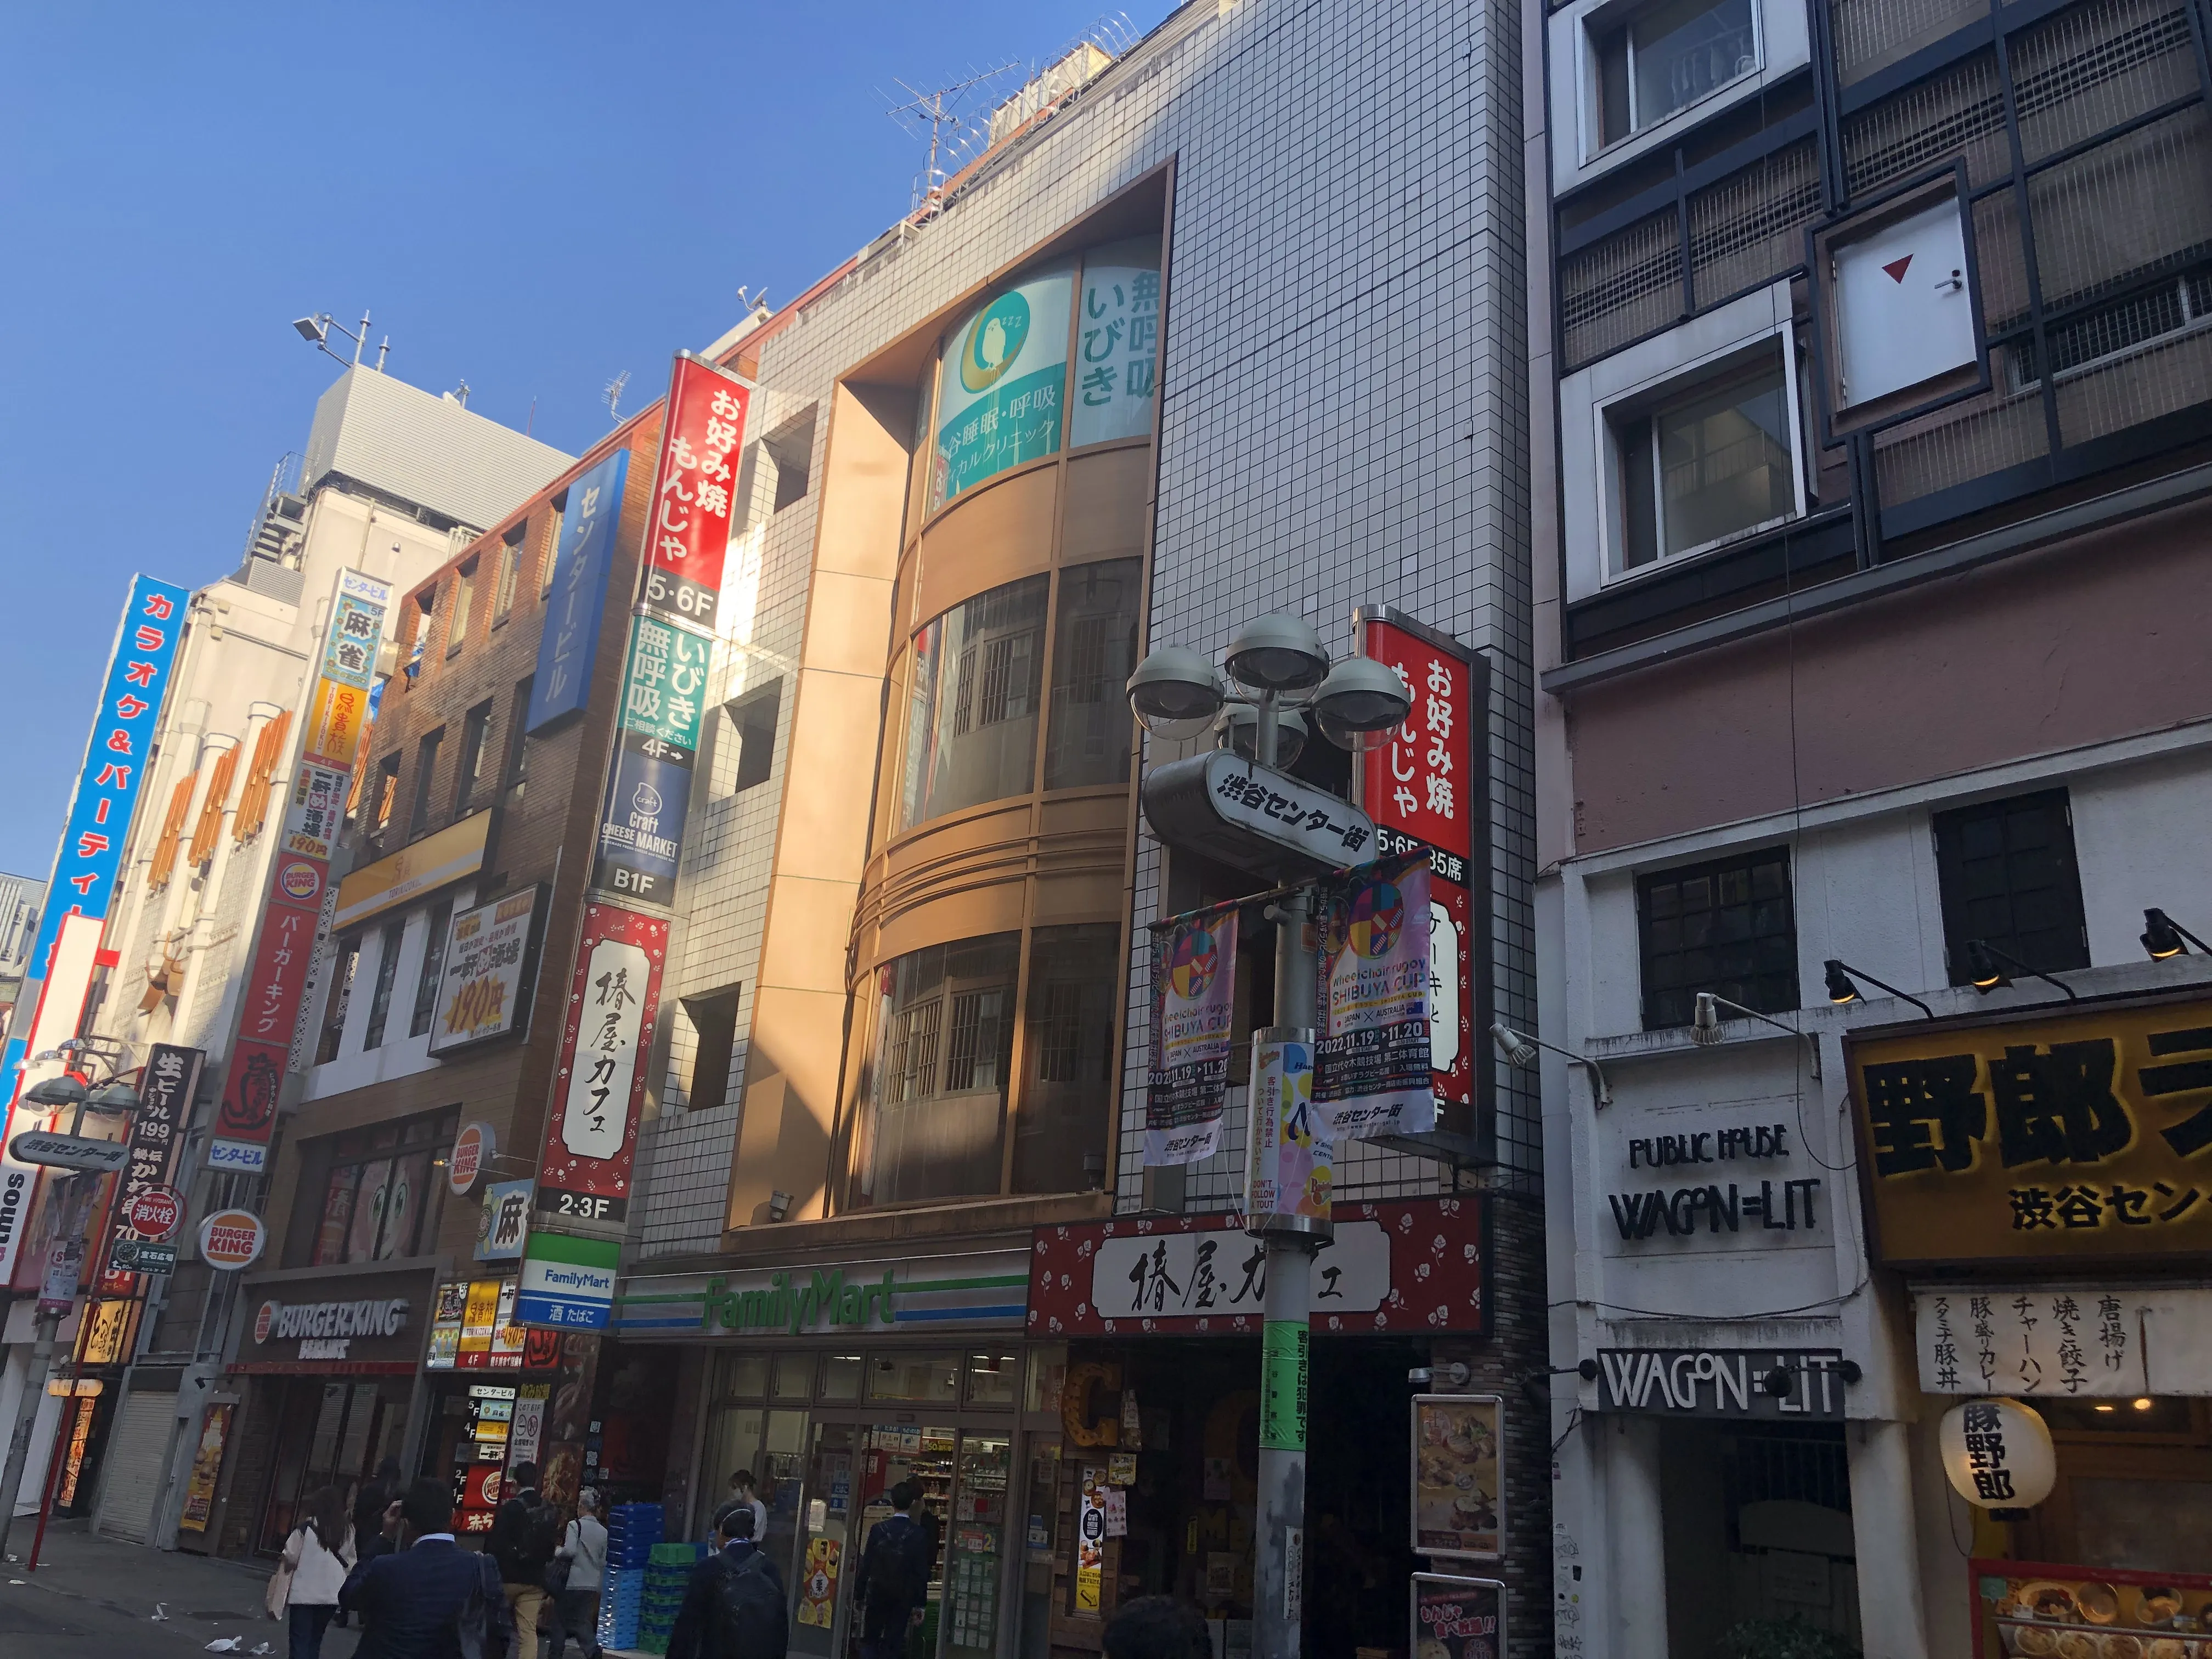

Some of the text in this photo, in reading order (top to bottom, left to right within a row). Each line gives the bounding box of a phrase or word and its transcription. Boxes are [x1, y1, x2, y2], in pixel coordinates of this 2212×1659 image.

[1082, 284, 1125, 407] いびき
[696, 389, 741, 518] お好み焼
[659, 436, 697, 561] もんじゃ
[344, 577, 387, 600] センタービル
[545, 486, 600, 702] センタービル
[370, 607, 384, 618] 5F
[338, 611, 372, 670] 麻雀
[629, 620, 671, 721] 無呼吸
[668, 633, 705, 730] いびき
[327, 692, 354, 755] 鳥貴族
[624, 716, 692, 746] ご相談ください
[642, 738, 669, 758] 4F
[1426, 659, 1454, 820] お好み焼
[629, 811, 659, 834] Craft
[1217, 772, 1370, 853] 渋谷センター街
[602, 823, 678, 859] CHEESE MARKET
[284, 877, 315, 888] KING
[285, 871, 315, 880] BURGER
[613, 868, 654, 894] B1F
[258, 915, 300, 1033] バーガーキング
[1333, 966, 1390, 988] wheelchair
[1332, 972, 1426, 1006] SHIBUYA CUP
[1344, 1012, 1361, 1024] JAPAN
[1376, 1004, 1405, 1018] AUSTRALIA
[1388, 1021, 1423, 1041] 11.20
[583, 967, 637, 1133] 椿屋カフェ
[1193, 1042, 1220, 1053] AUSTRALIA
[1324, 1047, 1430, 1074] 国立代々木競技場 第二体育館
[149, 1052, 184, 1120] 生ビール
[1264, 1076, 1276, 1148] 客引き行為禁止
[1333, 1103, 1403, 1125] 渋谷センター街
[139, 1120, 170, 1138] 199
[24, 1138, 125, 1163] 渋谷センター街
[132, 1147, 163, 1163] 秘伝
[211, 1144, 263, 1165] センタービル
[456, 1144, 479, 1159] BURGER
[1629, 1124, 1790, 1169] PUBLIC HOUSE
[453, 1156, 478, 1175] KING
[1251, 1189, 1276, 1199] FOLLOW
[1252, 1179, 1273, 1189] DON'T
[134, 1203, 174, 1224] 消火栓
[1256, 1200, 1274, 1209] TOUT
[2008, 1181, 2212, 1230] 渋谷セン
[211, 1227, 256, 1241] BURGER
[140, 1250, 174, 1262] 宝石広場
[208, 1237, 254, 1255] KING
[545, 1268, 610, 1289] FamilyMart
[1129, 1239, 1343, 1312] 椿屋カェ
[468, 1301, 494, 1323] 鳥貴族
[702, 1266, 898, 1336] FamilyMart
[276, 1302, 352, 1339] BURGER
[349, 1297, 410, 1336] KING
[549, 1304, 595, 1323] 酒 たばこ
[466, 1327, 490, 1336] TORIKIZOKU
[2097, 1294, 2127, 1372] 唐揚げ
[1934, 1297, 1961, 1391] スタミナ豚丼
[1970, 1297, 1995, 1392] 豚盛りカレー
[2012, 1295, 2042, 1393] チャーハン
[2052, 1295, 2088, 1395] 焼き餃子
[468, 1354, 479, 1365] 4F
[476, 1387, 514, 1397] センタービル
[1295, 1330, 1309, 1443] 客引きは犯罪です
[468, 1400, 480, 1416] 5F
[464, 1422, 476, 1438] 4F
[1963, 1403, 2016, 1501] 豚野郎
[455, 1469, 466, 1485] 2F
[453, 1487, 464, 1504] 1F
